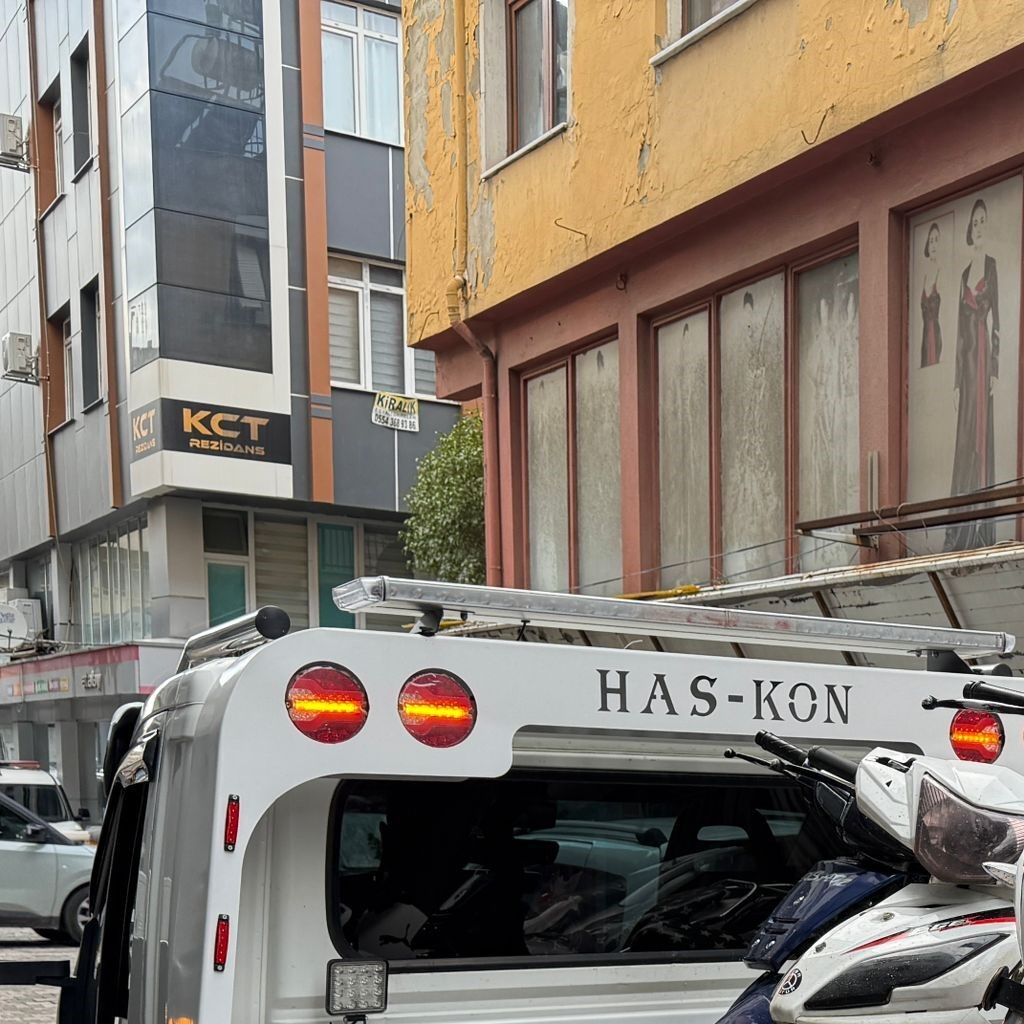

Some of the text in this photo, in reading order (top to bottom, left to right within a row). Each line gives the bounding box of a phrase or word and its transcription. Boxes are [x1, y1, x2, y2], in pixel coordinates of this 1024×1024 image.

[133, 408, 156, 441] KCT
[182, 407, 269, 441] KCT
[189, 438, 265, 456] REZİDANS
[595, 668, 854, 725] HAS-KON
